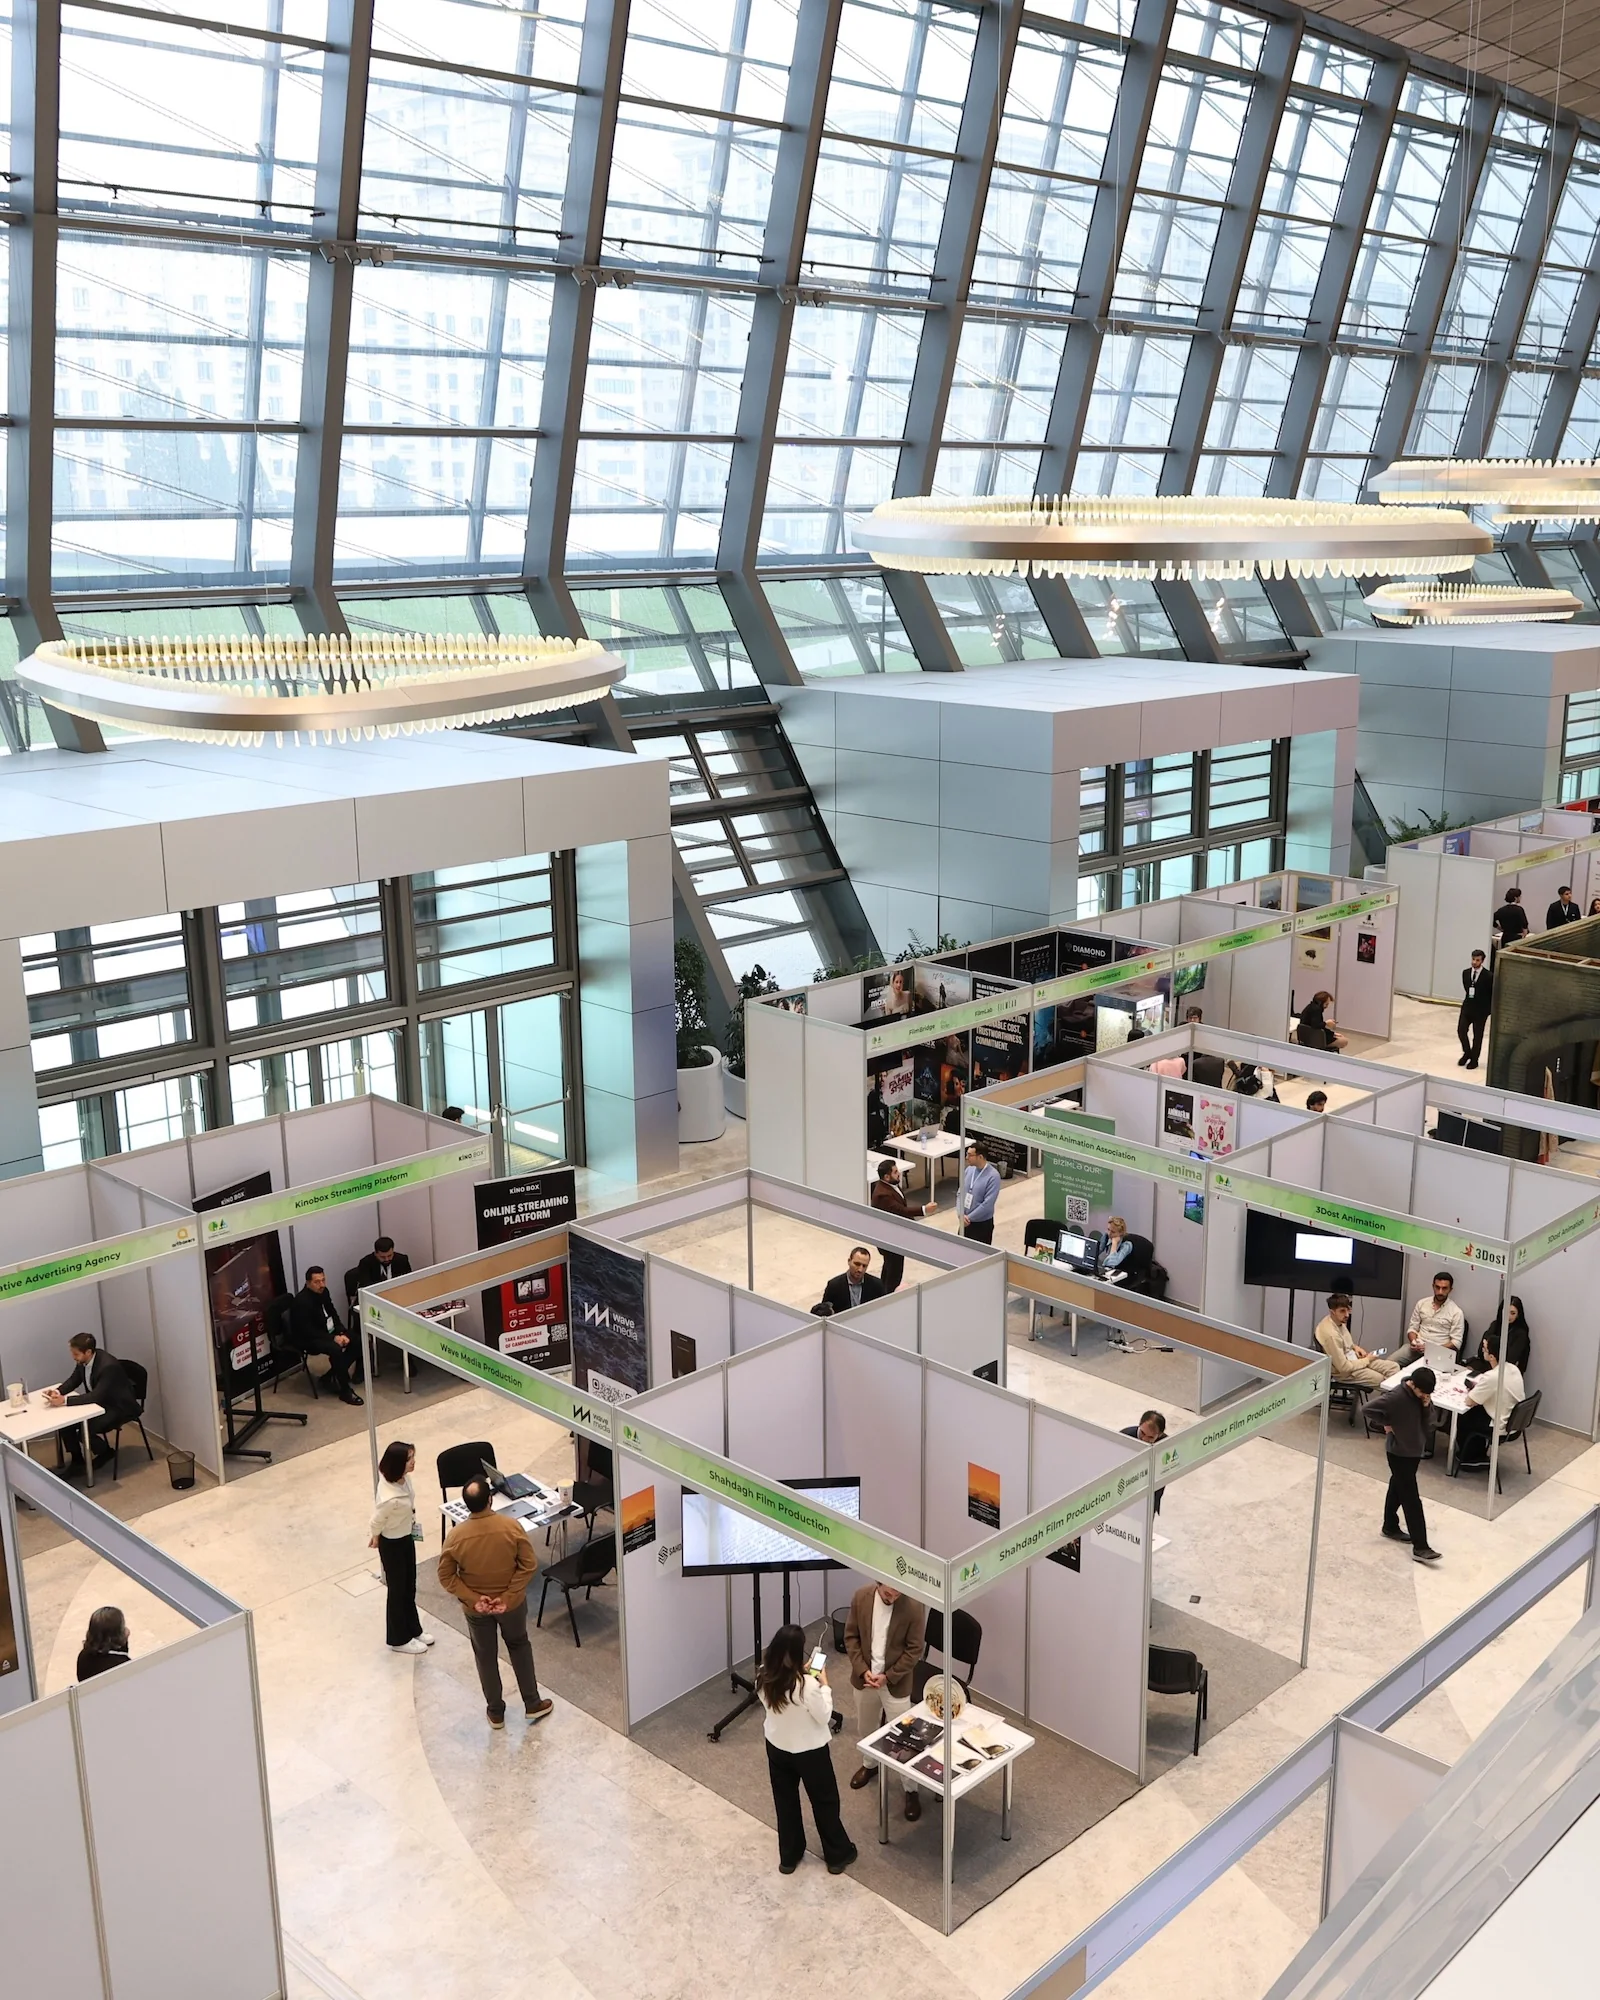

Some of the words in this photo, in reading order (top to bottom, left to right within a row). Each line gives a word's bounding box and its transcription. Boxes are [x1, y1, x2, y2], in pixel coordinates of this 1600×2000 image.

[1072, 944, 1106, 957] DIAMOND
[888, 1069, 914, 1089] FAMILY
[1023, 1124, 1058, 1140] Azerbaijan
[1059, 1132, 1095, 1150] Animation
[1095, 1143, 1136, 1162] Association
[1168, 1163, 1202, 1181] anima
[294, 1192, 330, 1209] Kinobox
[330, 1180, 373, 1200] Streaming
[374, 1170, 409, 1188] Platform
[525, 1183, 540, 1192] BOX
[483, 1204, 516, 1218] ONLINE
[517, 1195, 569, 1213] STREAMING
[503, 1209, 551, 1226] PLATFORM
[1315, 1205, 1340, 1220] 3Dost
[1341, 1212, 1386, 1232] Animation
[1475, 1247, 1506, 1266] 3Dost
[25, 1260, 83, 1285] Advertising
[84, 1251, 122, 1269] Agency
[612, 1312, 635, 1329] wave
[612, 1323, 638, 1341] media
[440, 1342, 460, 1359] Wave
[460, 1352, 482, 1369] Media
[483, 1362, 523, 1389] Production
[592, 1413, 609, 1426] wave
[592, 1420, 611, 1434] media
[1202, 1427, 1228, 1446] Chinar
[1228, 1418, 1245, 1433] Film
[1246, 1396, 1286, 1423] Production
[709, 1469, 754, 1502] Shahdagh
[755, 1491, 776, 1510] Film
[777, 1502, 831, 1536] Production
[999, 1529, 1044, 1562] Shahdagh
[1045, 1518, 1065, 1536] Film
[1066, 1489, 1112, 1523] Production
[928, 1574, 942, 1589] FİLM
